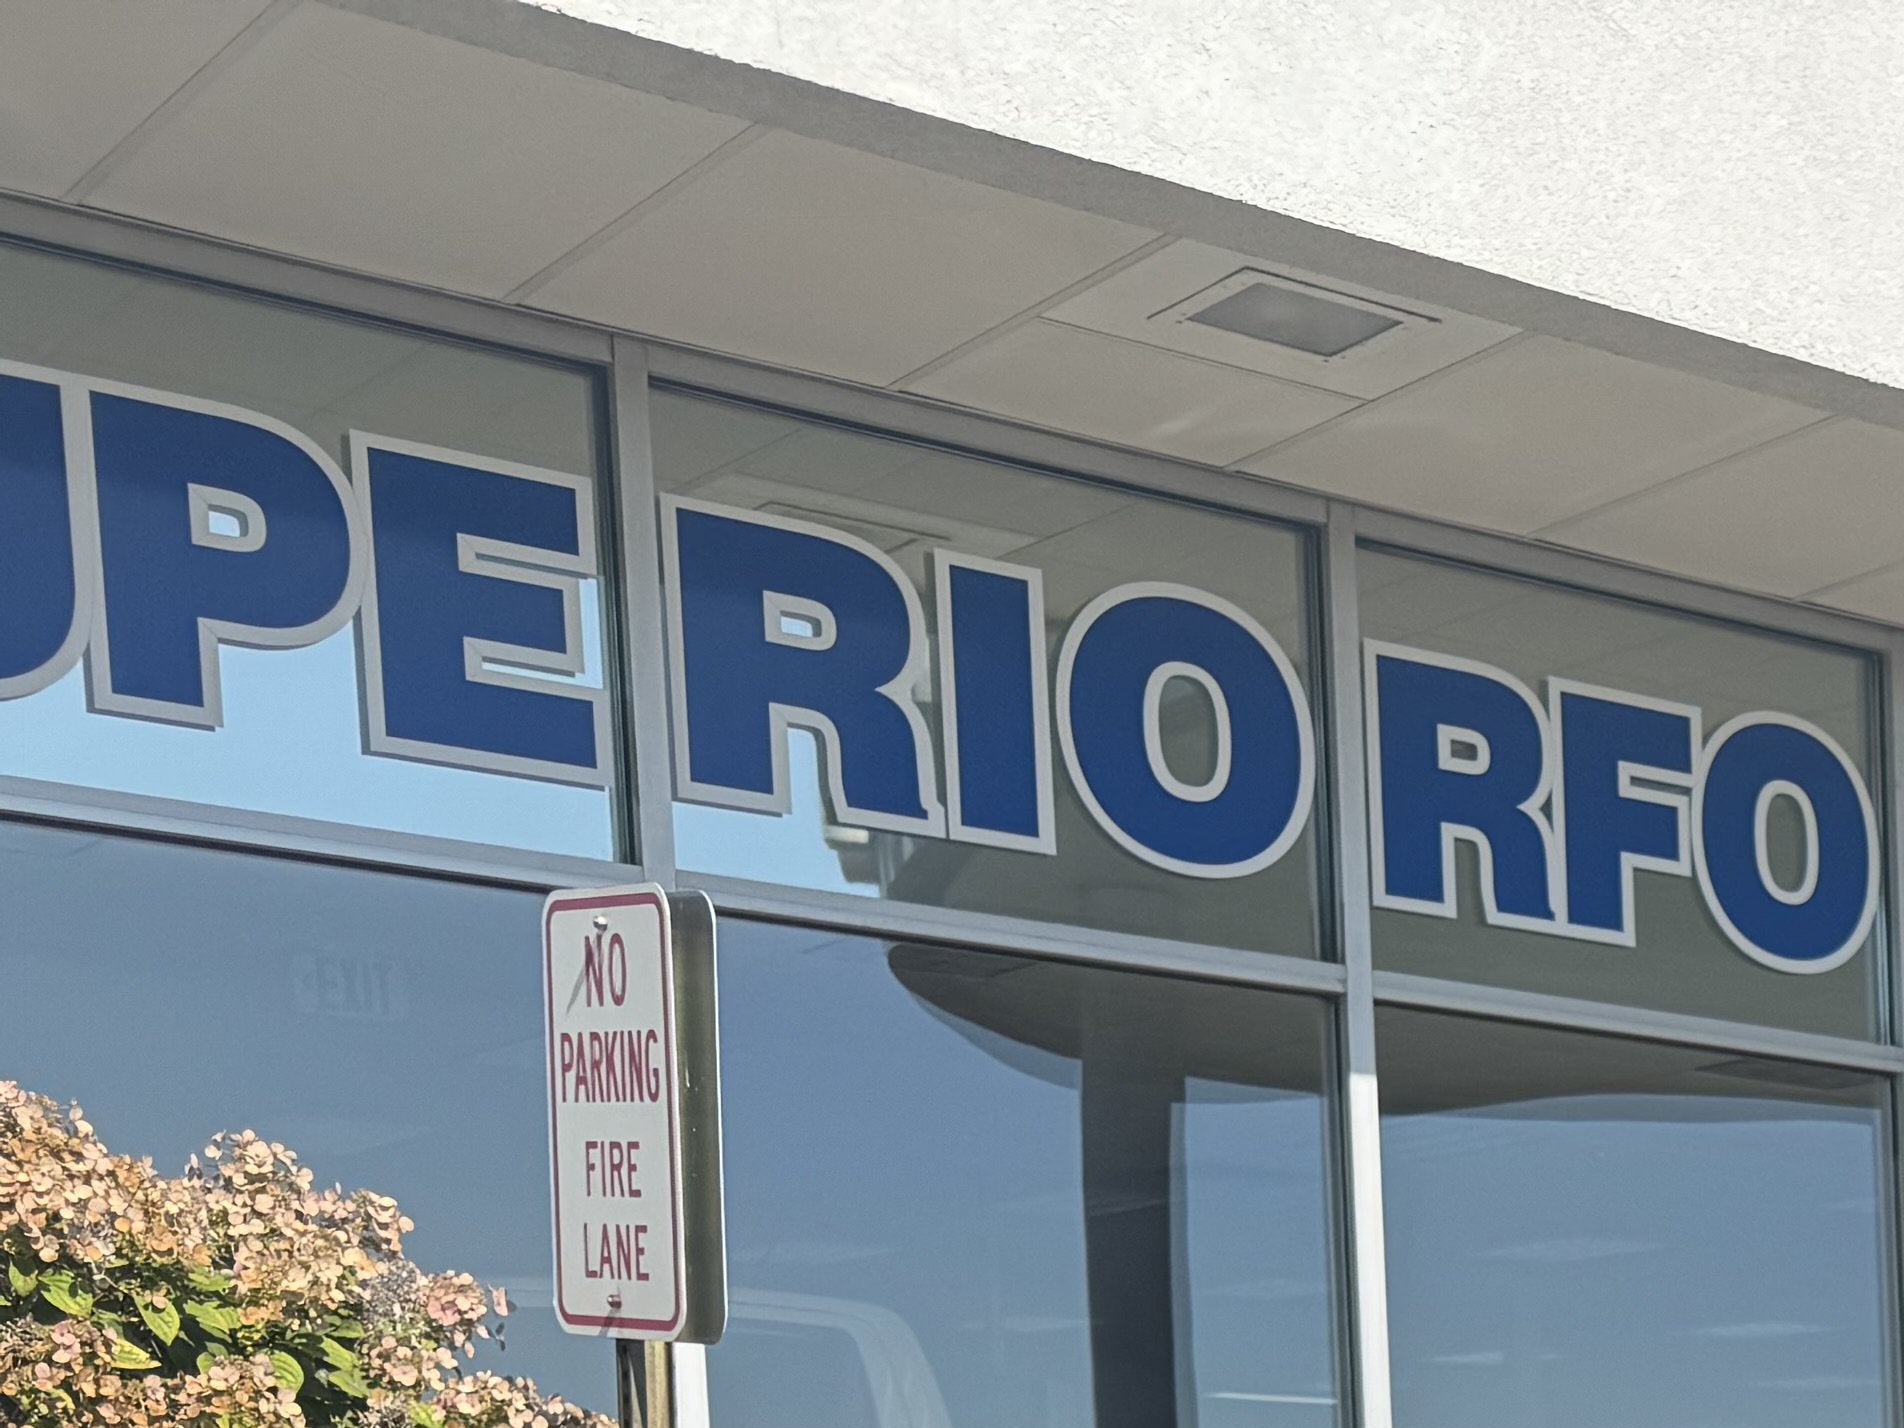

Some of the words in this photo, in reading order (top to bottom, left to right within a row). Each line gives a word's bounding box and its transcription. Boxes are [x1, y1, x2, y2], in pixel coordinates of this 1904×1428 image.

[584, 933, 627, 1007] NO
[560, 1028, 660, 1103] PARKING
[585, 1140, 642, 1198] FIRE
[583, 1222, 650, 1281] LANE
